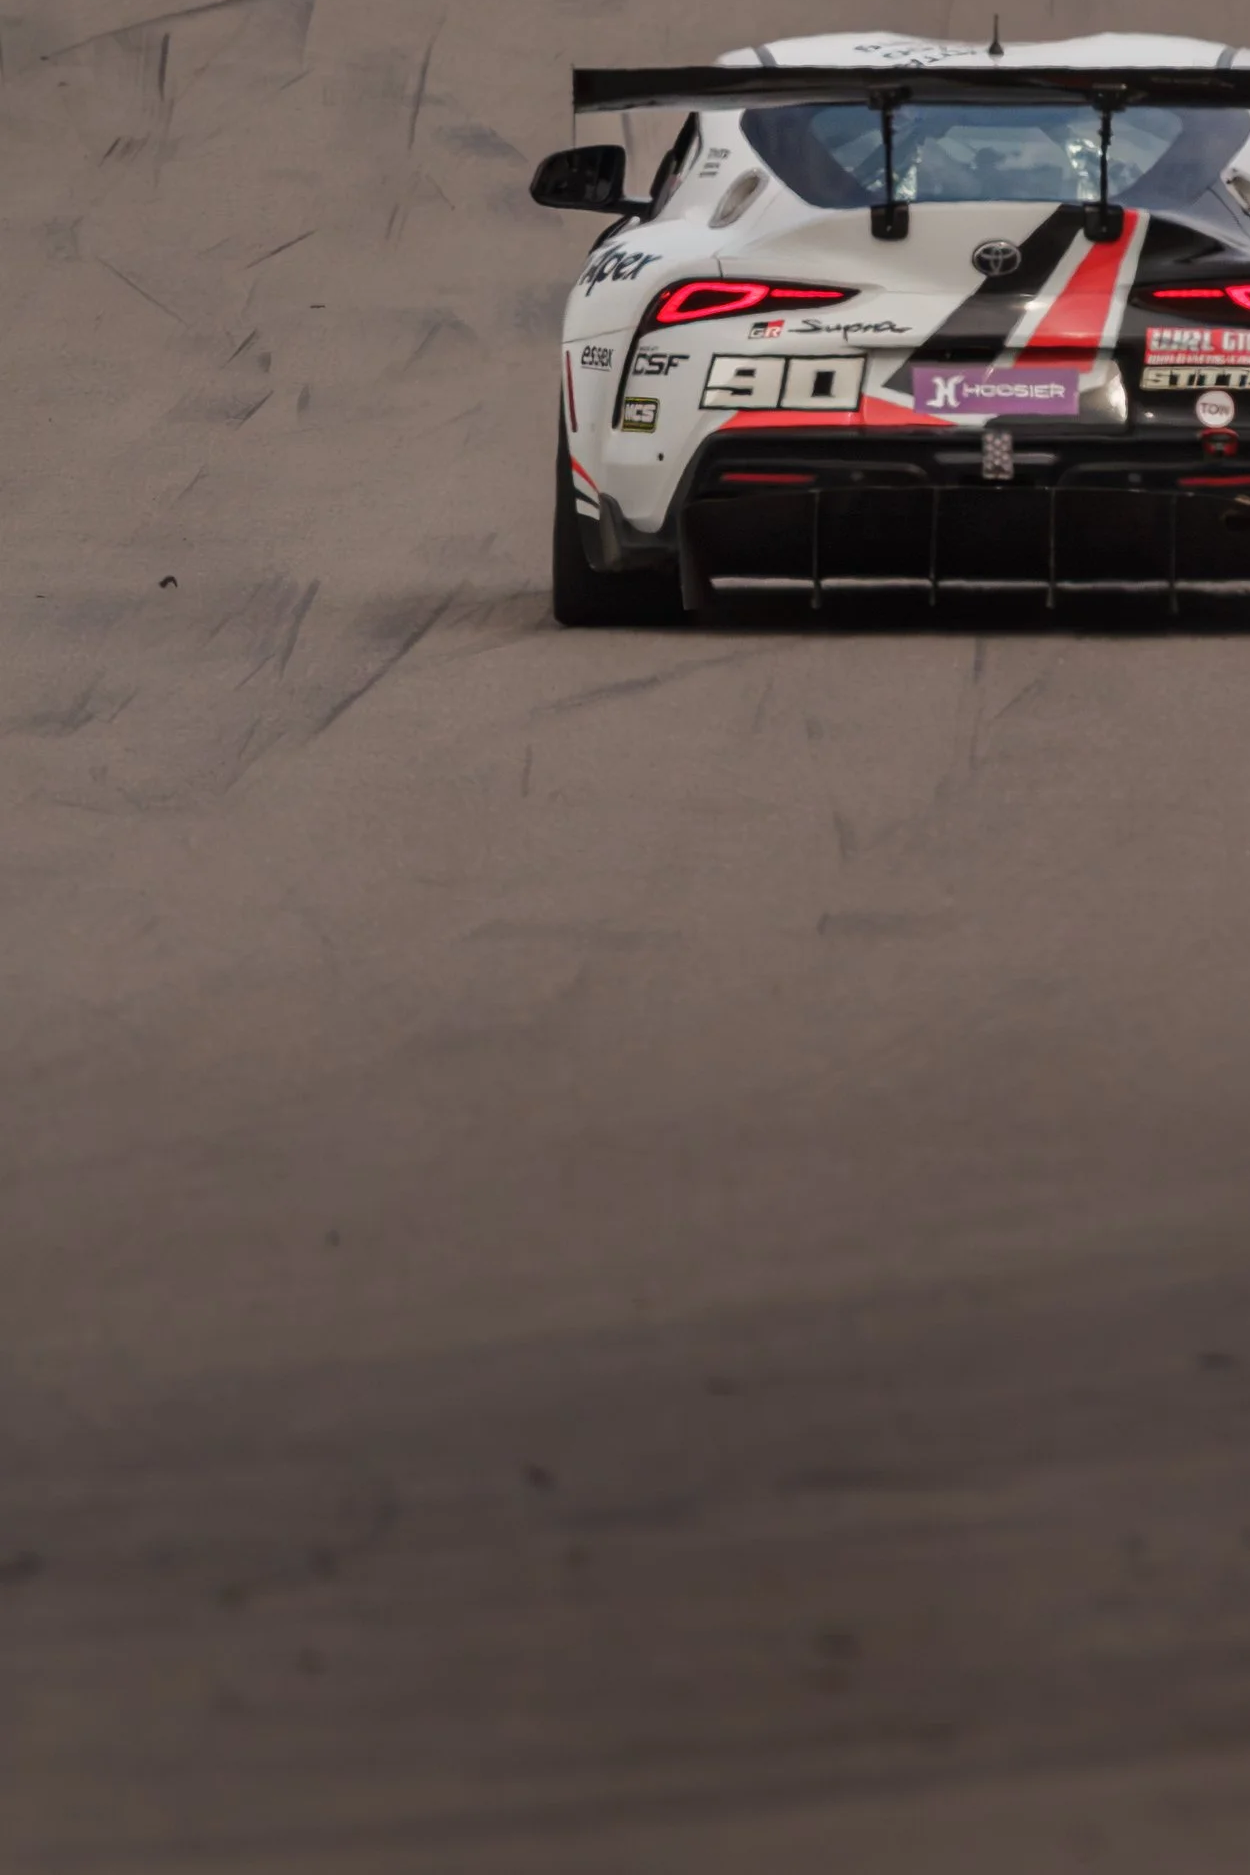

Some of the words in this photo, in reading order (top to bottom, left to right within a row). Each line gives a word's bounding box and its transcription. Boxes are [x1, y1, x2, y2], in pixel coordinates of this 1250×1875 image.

[749, 324, 782, 339] GR
[788, 319, 913, 342] Supra
[632, 353, 690, 375] CSF
[700, 354, 868, 412] 90
[962, 382, 1066, 399] HOOSIER
[624, 403, 657, 424] MCS
